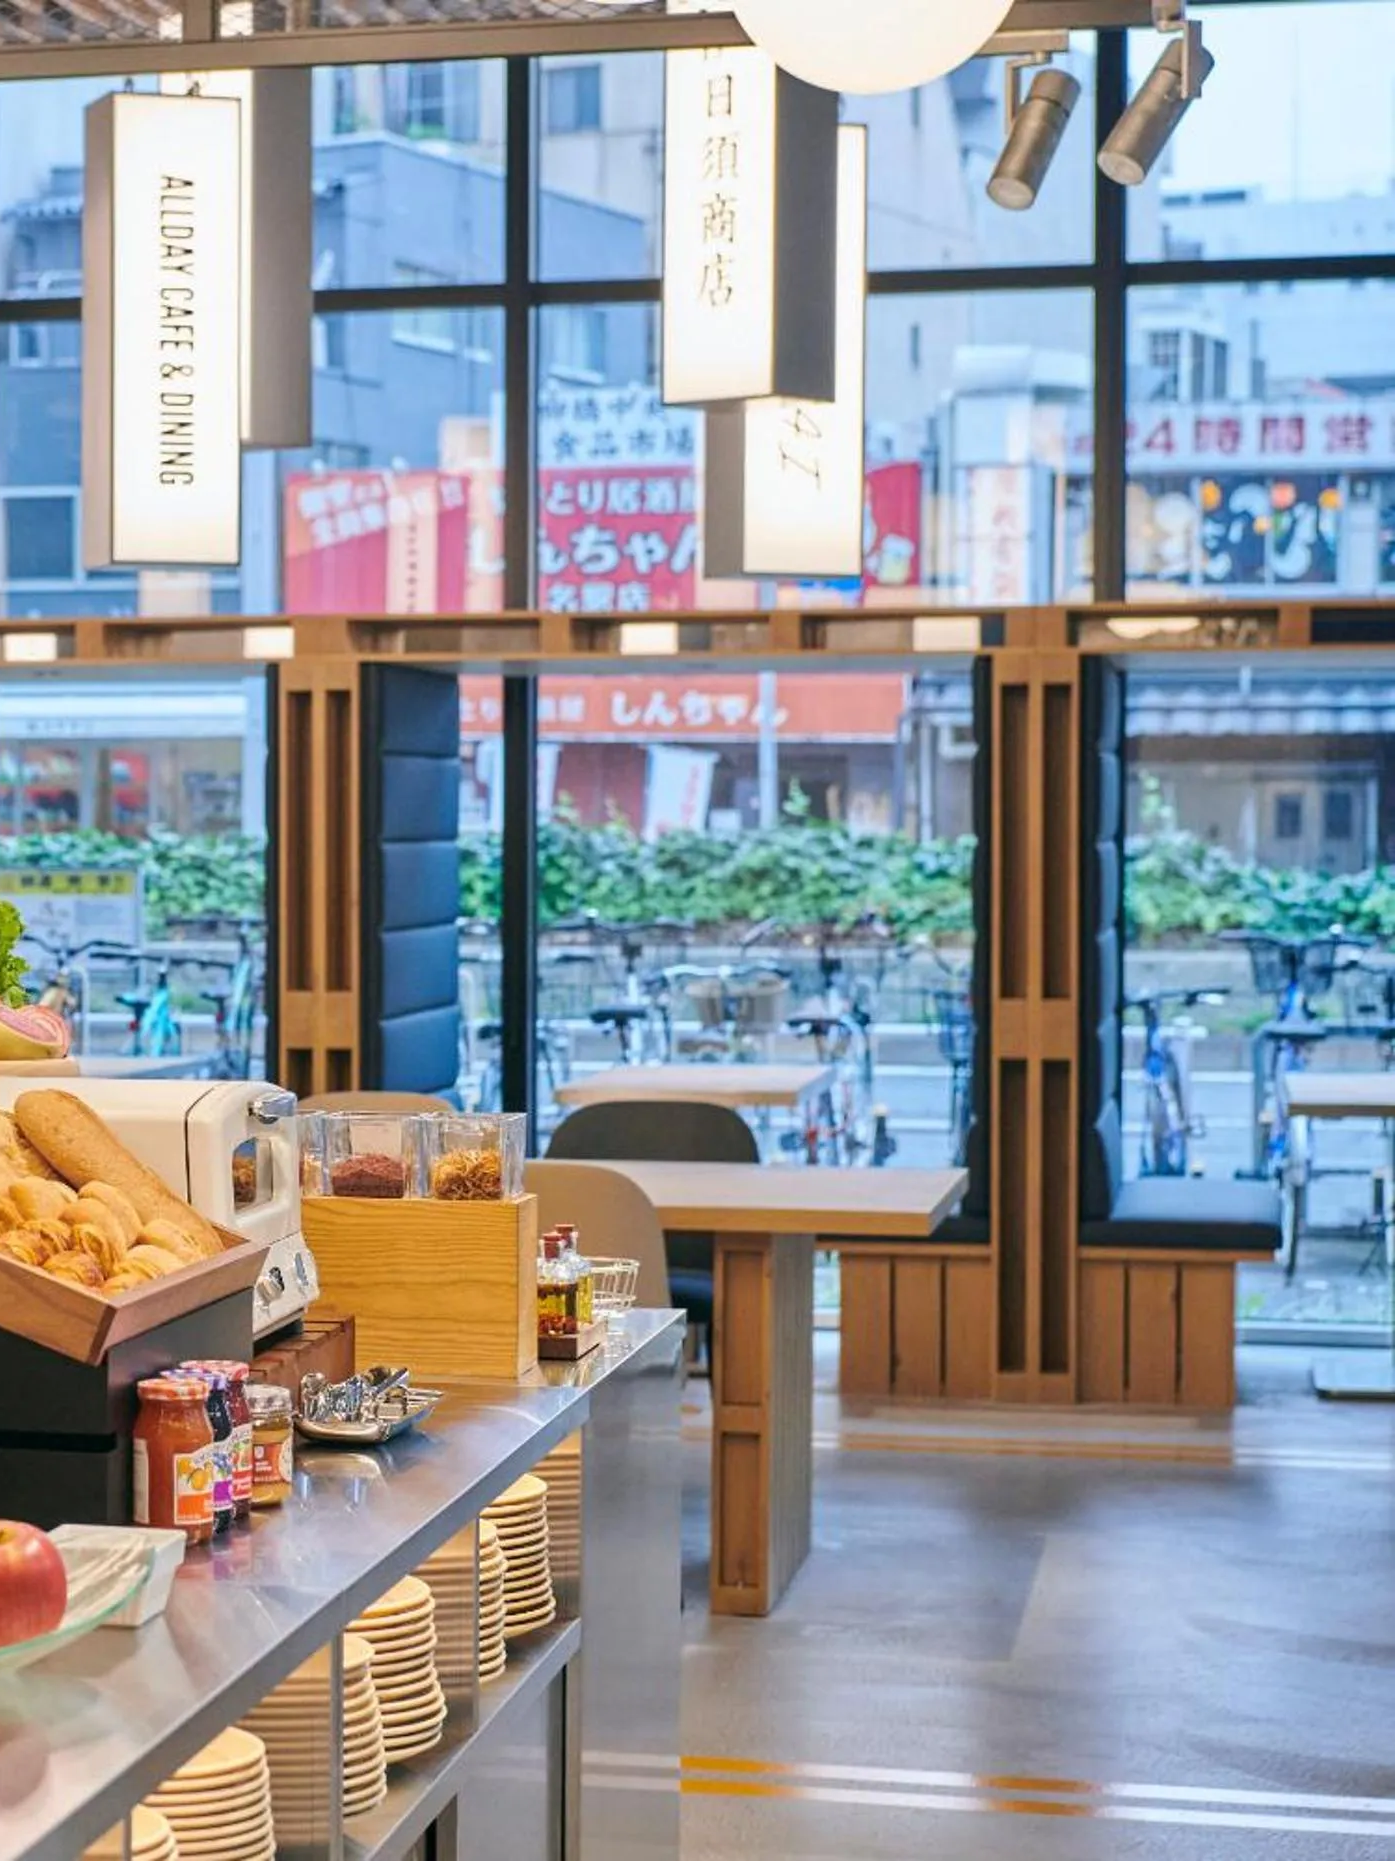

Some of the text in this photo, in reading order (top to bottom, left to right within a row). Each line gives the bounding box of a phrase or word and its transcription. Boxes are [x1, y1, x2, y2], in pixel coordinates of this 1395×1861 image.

[158, 174, 194, 485] ALLDAY CAFE & DINING
